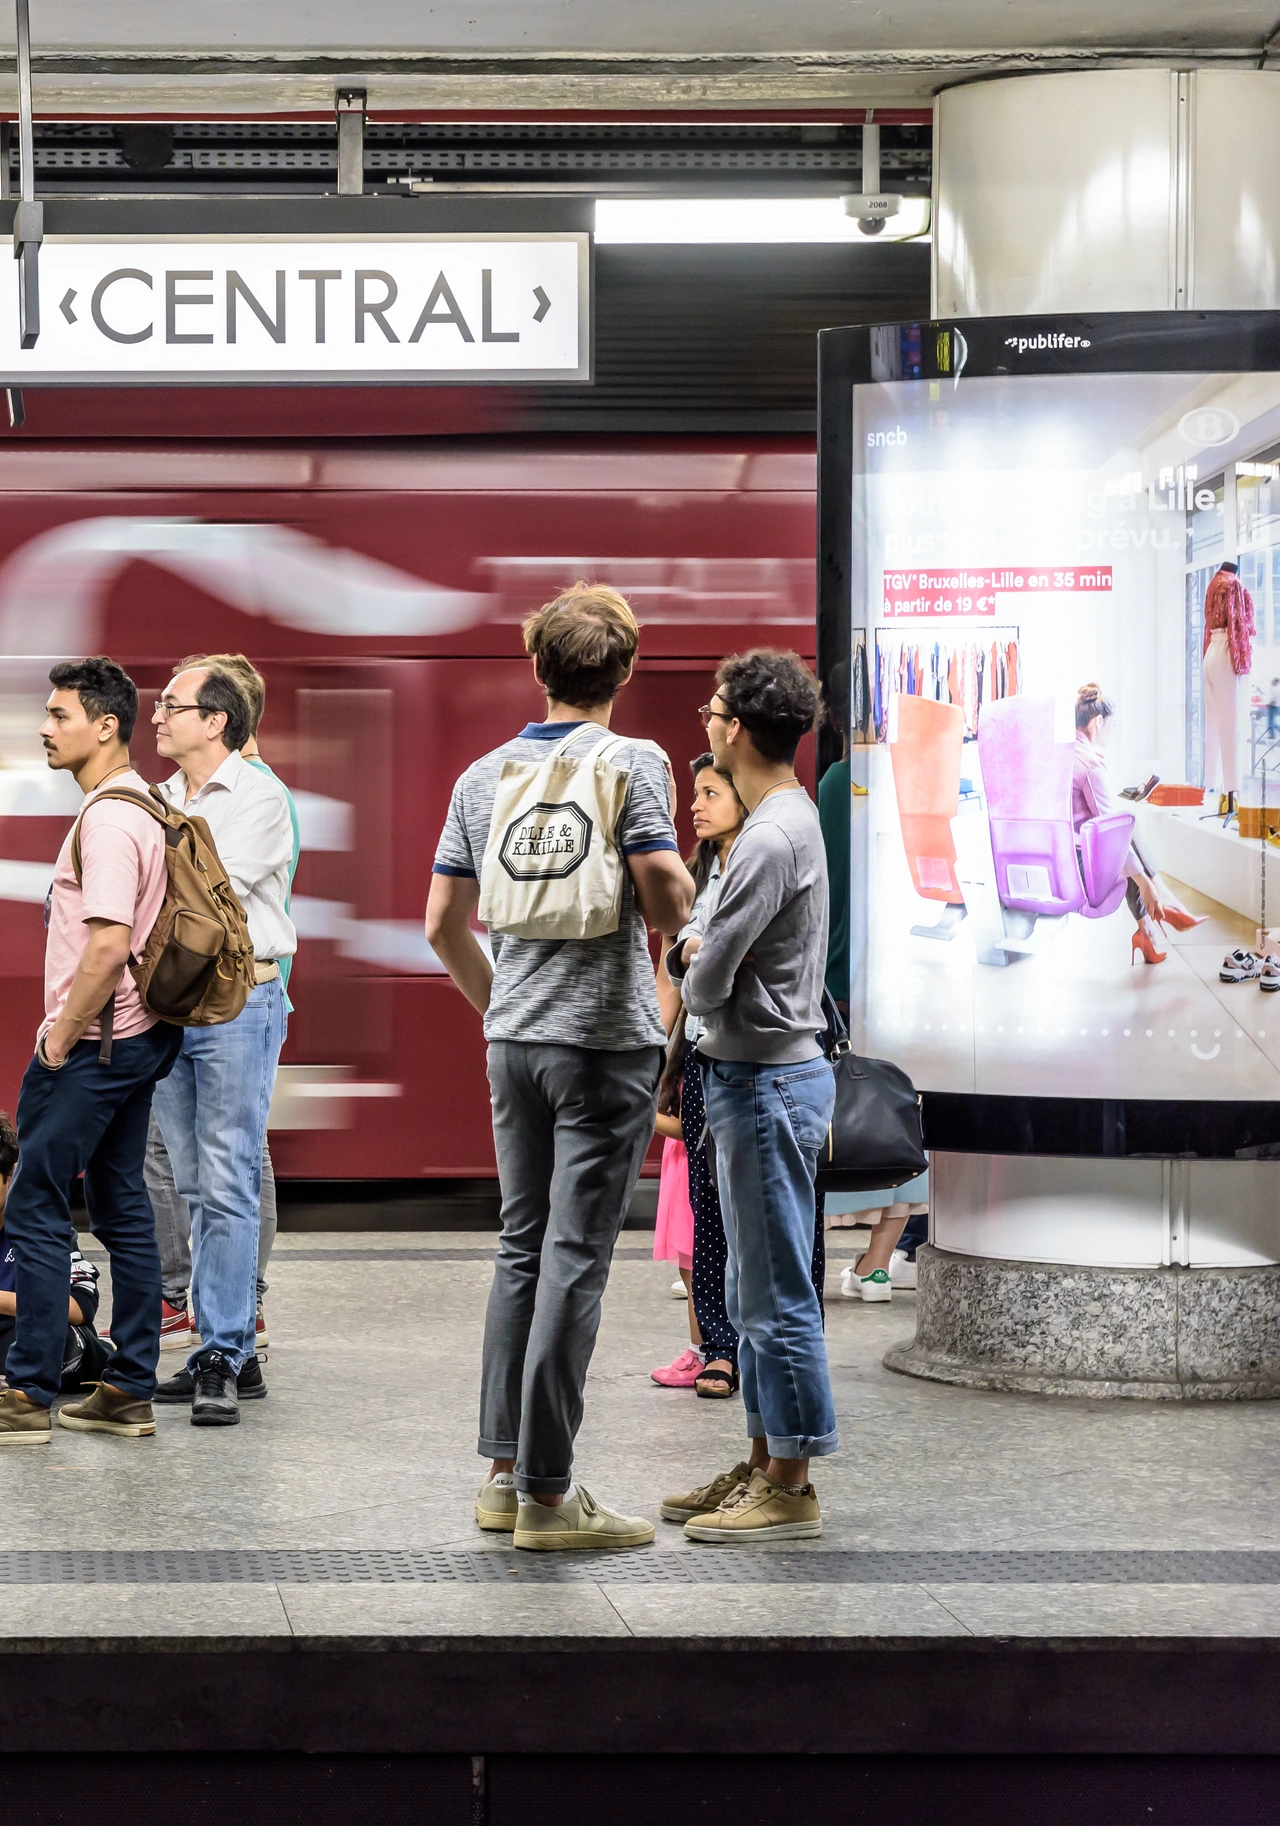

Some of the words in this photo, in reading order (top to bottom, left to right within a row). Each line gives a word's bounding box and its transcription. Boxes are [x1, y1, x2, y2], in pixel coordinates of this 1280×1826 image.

[868, 201, 888, 209] 2068
[1018, 332, 1081, 354] publifer
[867, 426, 907, 448] sncb
[919, 572, 1024, 590] Bruxelles-Lille
[1028, 575, 1049, 588] en
[1053, 571, 1074, 588] 35
[1080, 570, 1112, 587] min
[883, 597, 892, 613] à
[894, 596, 931, 616] partir
[933, 595, 952, 612] de
[956, 596, 972, 612] 19
[559, 823, 572, 837] &
